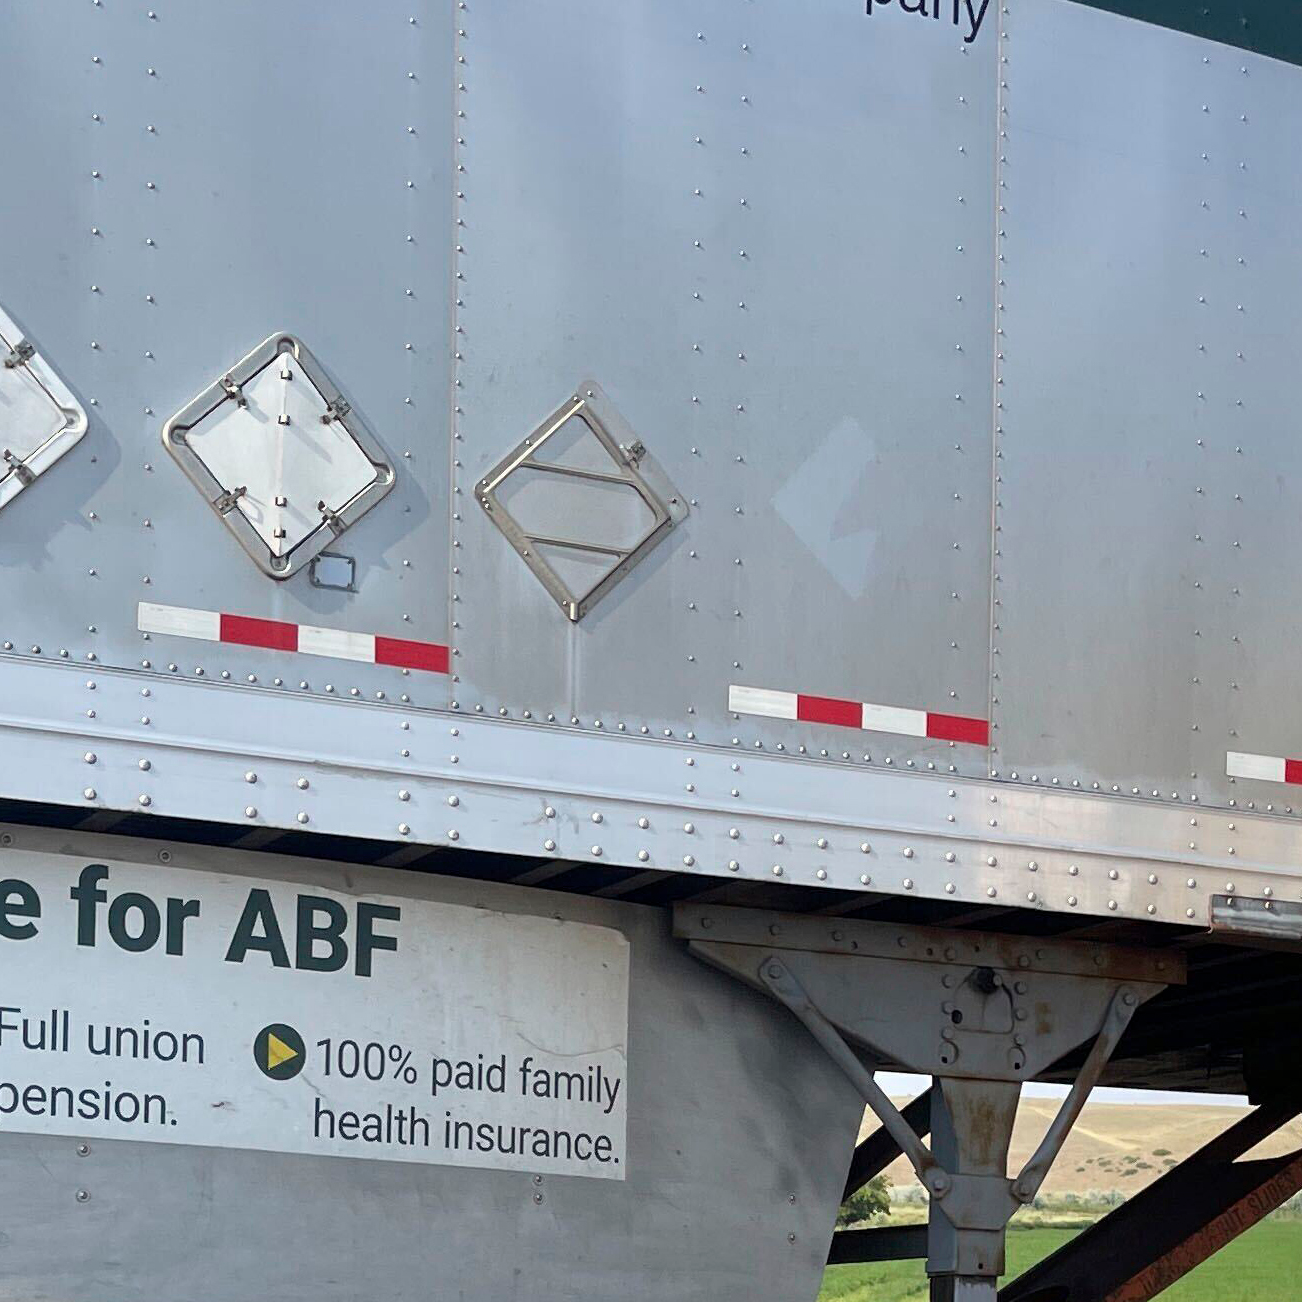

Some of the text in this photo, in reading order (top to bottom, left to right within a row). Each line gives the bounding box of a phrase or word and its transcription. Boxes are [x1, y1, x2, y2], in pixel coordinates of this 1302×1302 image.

[70, 862, 201, 957] for
[224, 888, 403, 978] ABF
[88, 1019, 204, 1064] union
[317, 1038, 621, 1113] 100% paid family
[314, 1097, 621, 1165] health insurance.
